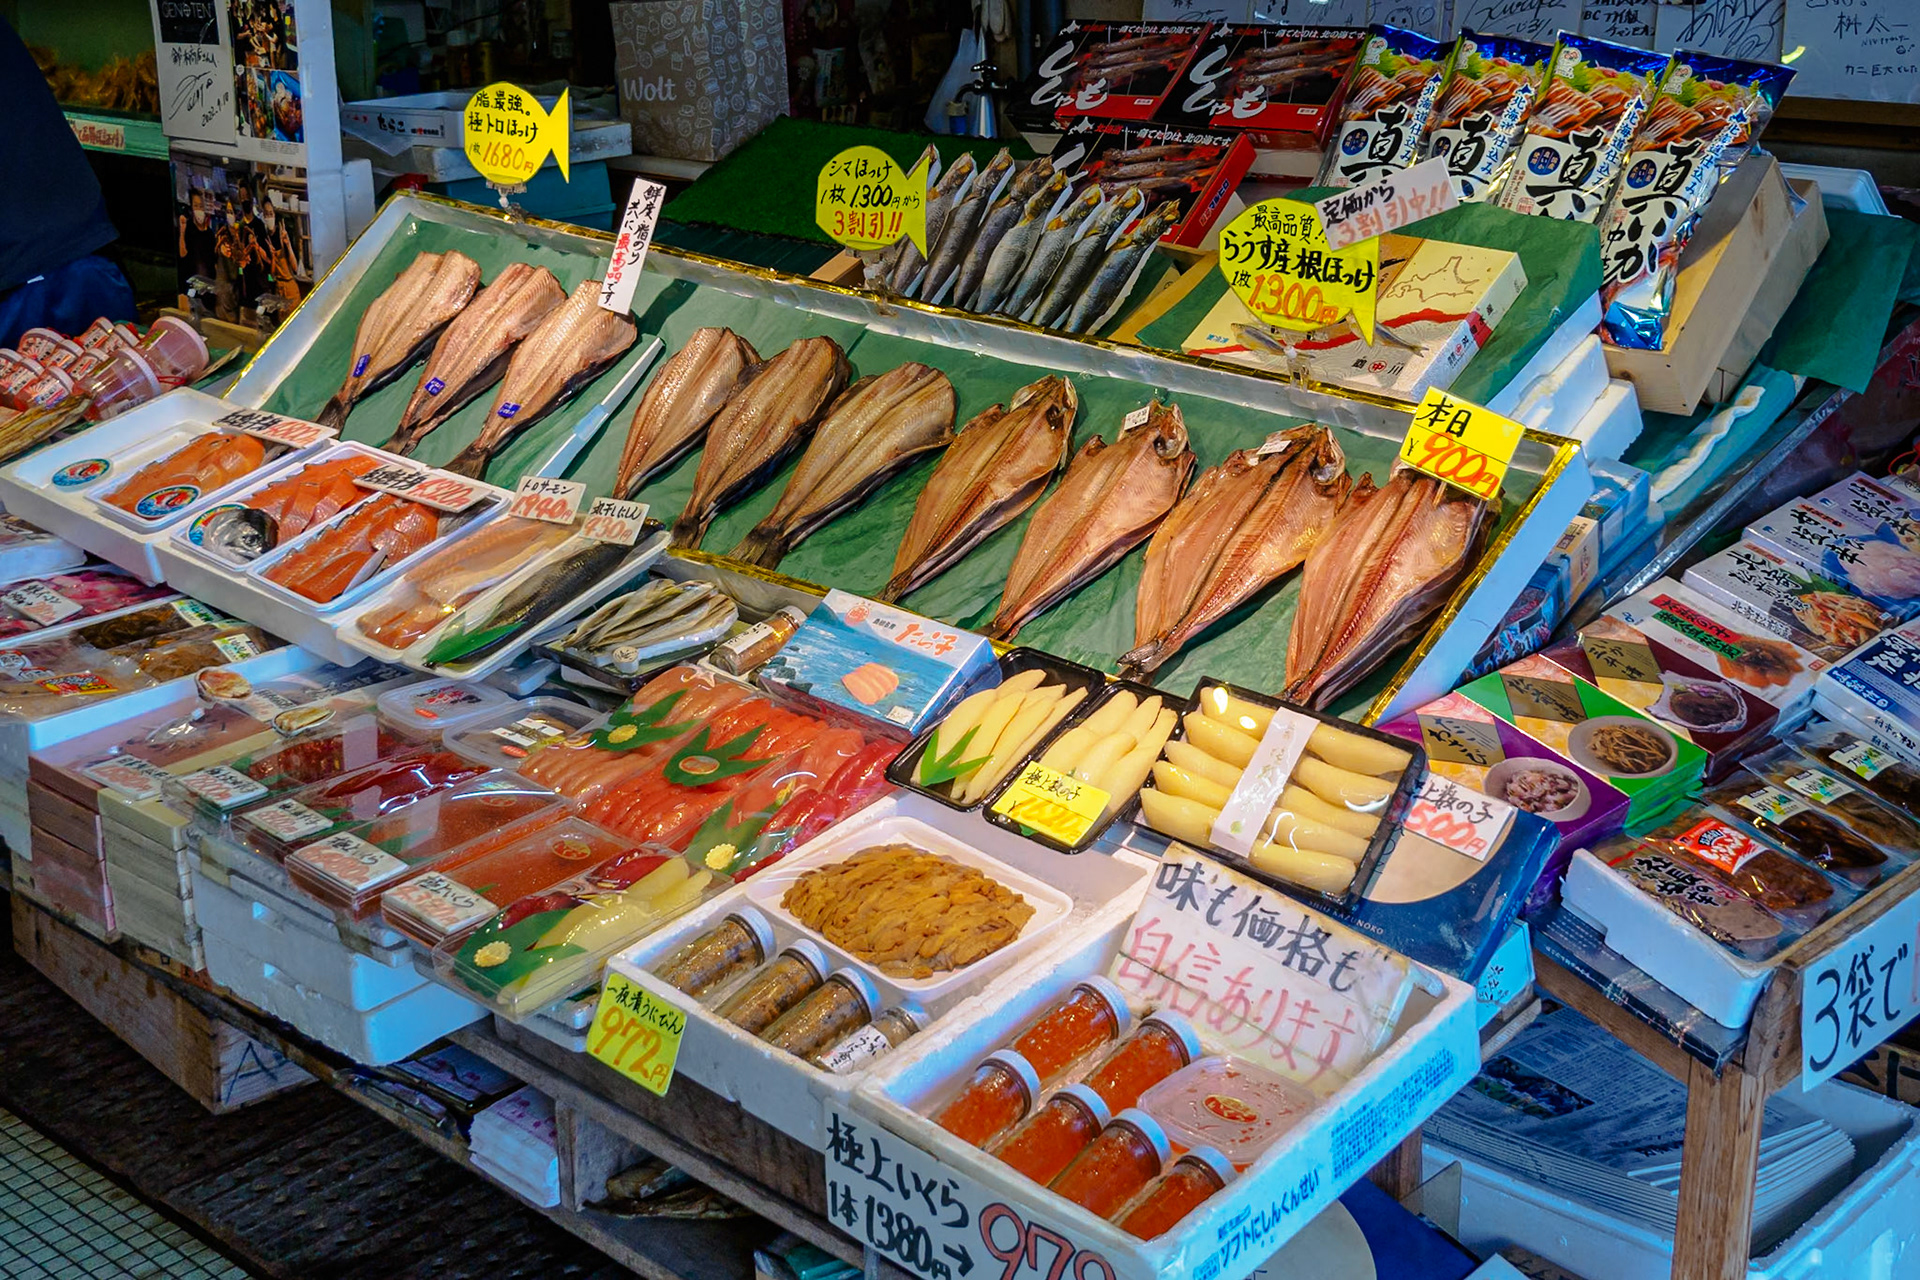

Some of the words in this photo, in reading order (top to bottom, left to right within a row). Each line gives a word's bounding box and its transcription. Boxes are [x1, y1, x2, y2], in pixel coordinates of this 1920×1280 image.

[623, 77, 678, 101] Wolt
[468, 111, 539, 144] 極トロほっけ
[828, 158, 893, 183] シマほっけ
[1321, 179, 1397, 230] 定価から
[1415, 395, 1472, 438] 本日
[522, 479, 575, 496] トロサーモン
[1156, 861, 1358, 992] 味も価格も
[1119, 916, 1357, 1084] 自信あります
[594, 1006, 670, 1088] 972円
[826, 1113, 970, 1228] 極上いくら
[829, 1181, 859, 1227] 1本
[1221, 1168, 1319, 1268] ソフトにしんくんせい
